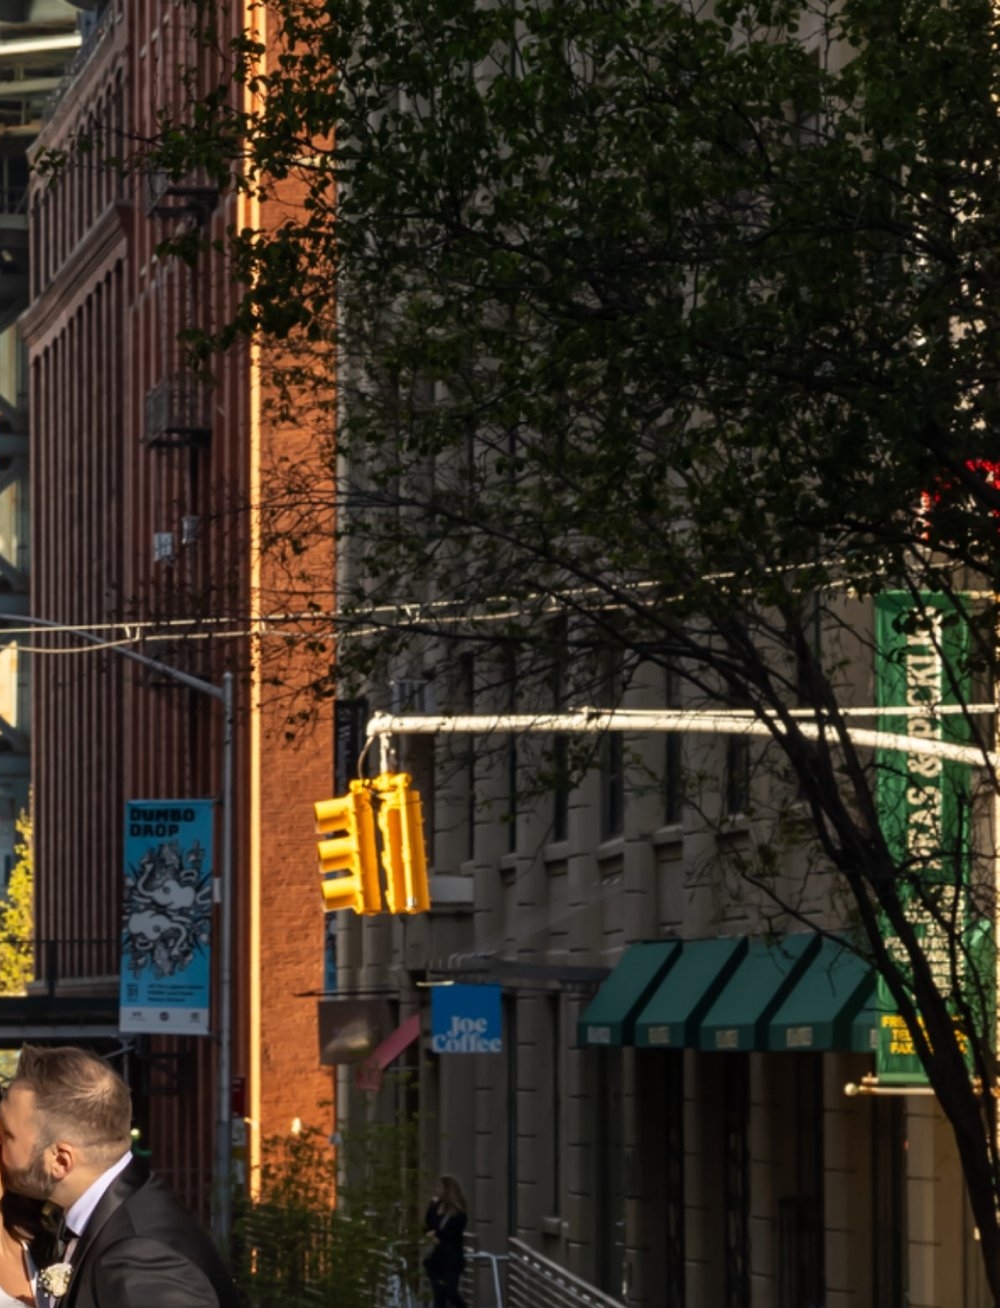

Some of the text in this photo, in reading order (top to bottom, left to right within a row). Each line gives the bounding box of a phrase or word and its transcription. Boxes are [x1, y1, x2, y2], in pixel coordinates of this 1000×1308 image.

[129, 808, 195, 822] DUMBO
[129, 824, 179, 837] DROP
[447, 1016, 488, 1037] Joe
[432, 1032, 502, 1053] Coffee
